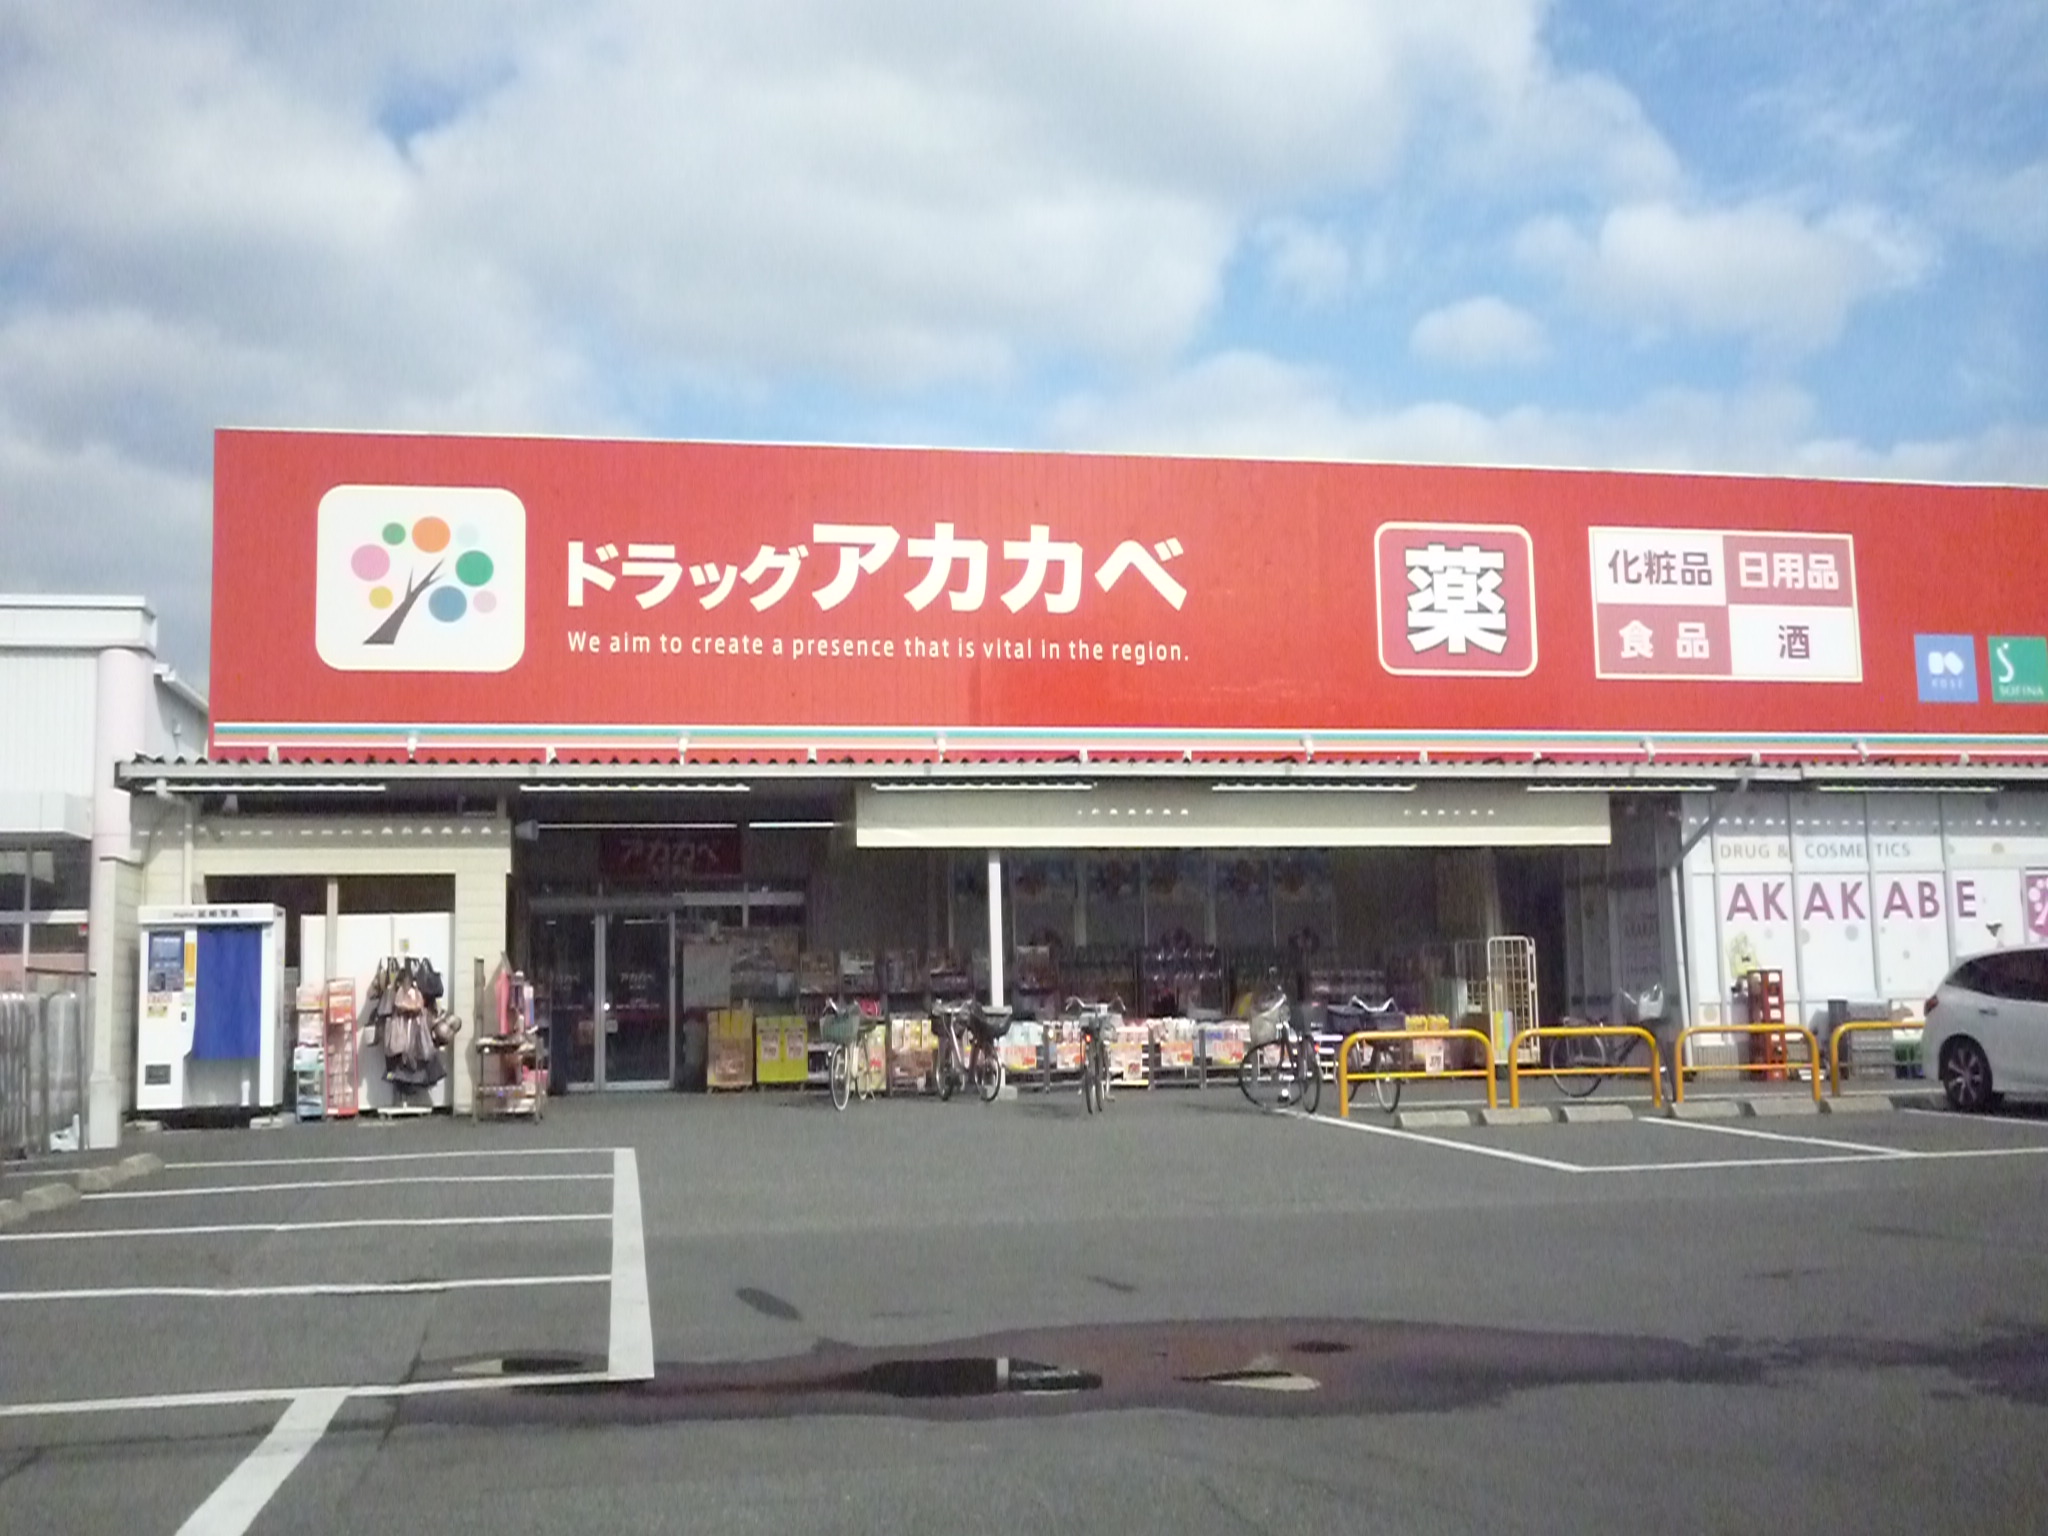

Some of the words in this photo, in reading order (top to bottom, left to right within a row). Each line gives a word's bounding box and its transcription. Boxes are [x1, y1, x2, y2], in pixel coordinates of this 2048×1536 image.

[567, 521, 1188, 614] ドラッグアカカベ
[1607, 549, 1713, 587] 化粧品
[1738, 551, 1840, 591] 日用品
[1404, 542, 1508, 656] 薬
[568, 631, 602, 653] We
[609, 631, 651, 653] aim
[659, 634, 683, 654] to
[691, 634, 764, 655] create
[772, 638, 784, 656] a
[792, 638, 895, 661] presence
[903, 637, 950, 659] that
[957, 638, 976, 659] is
[982, 638, 1032, 660] vital
[1041, 639, 1061, 660] in
[1068, 639, 1104, 661] the
[1112, 640, 1190, 665] region.
[1777, 624, 1811, 661] 酒
[1720, 843, 1771, 859] DRUG
